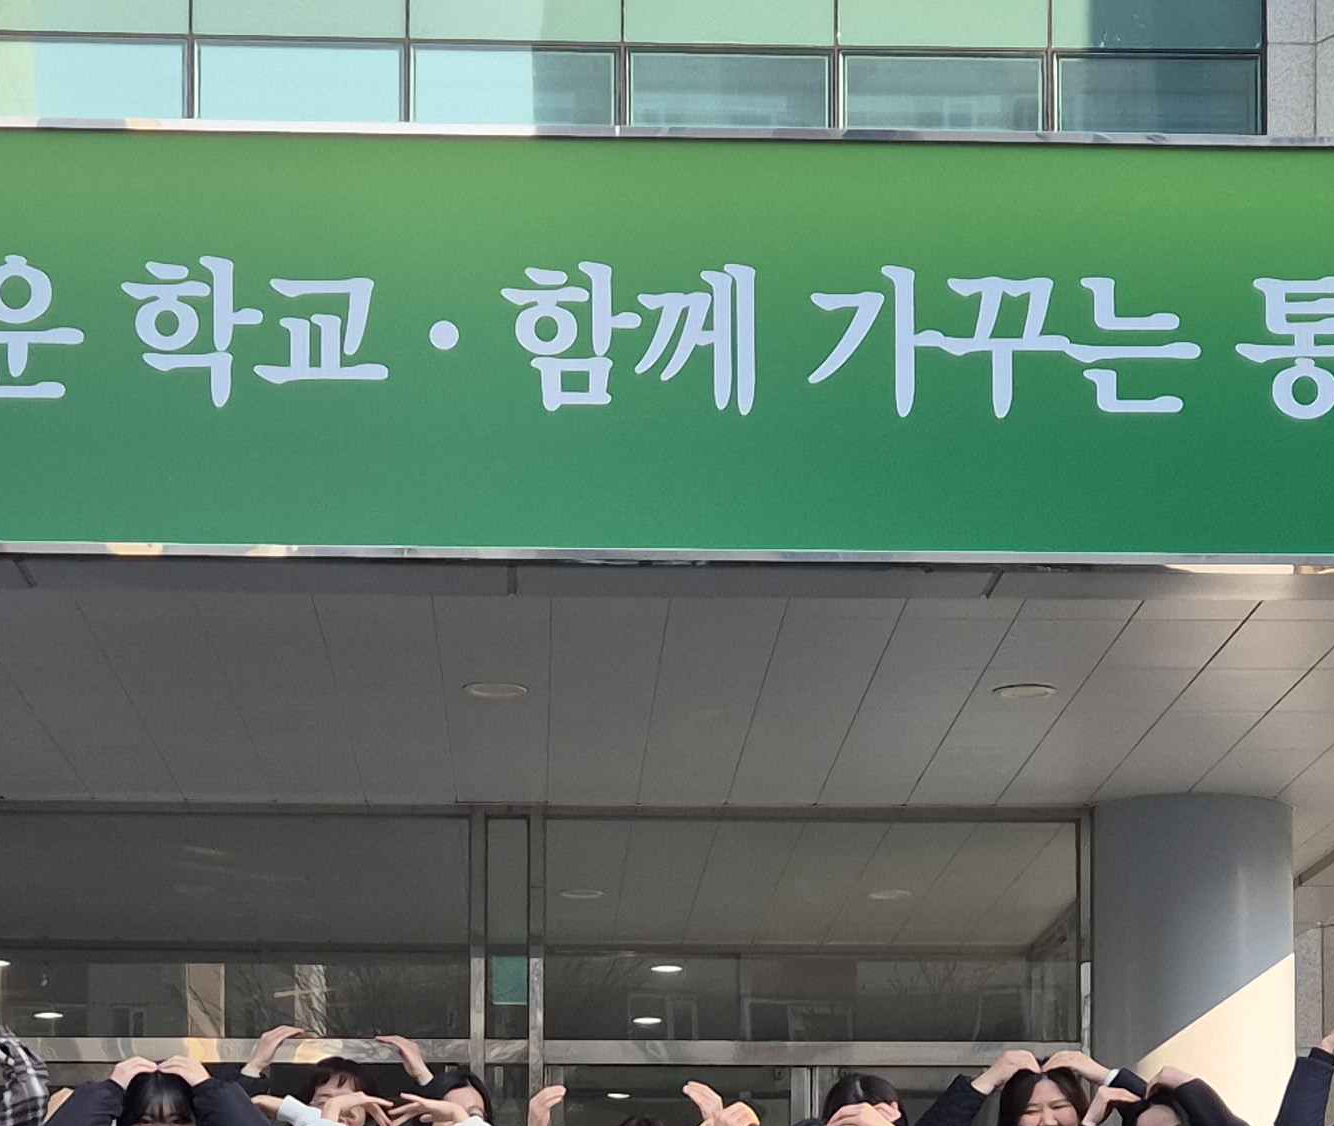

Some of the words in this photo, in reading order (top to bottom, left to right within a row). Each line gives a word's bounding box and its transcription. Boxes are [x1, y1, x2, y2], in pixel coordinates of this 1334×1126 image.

[120, 255, 389, 408] 학교
[500, 261, 756, 416] 함께
[807, 265, 1201, 419] 가꾸는
